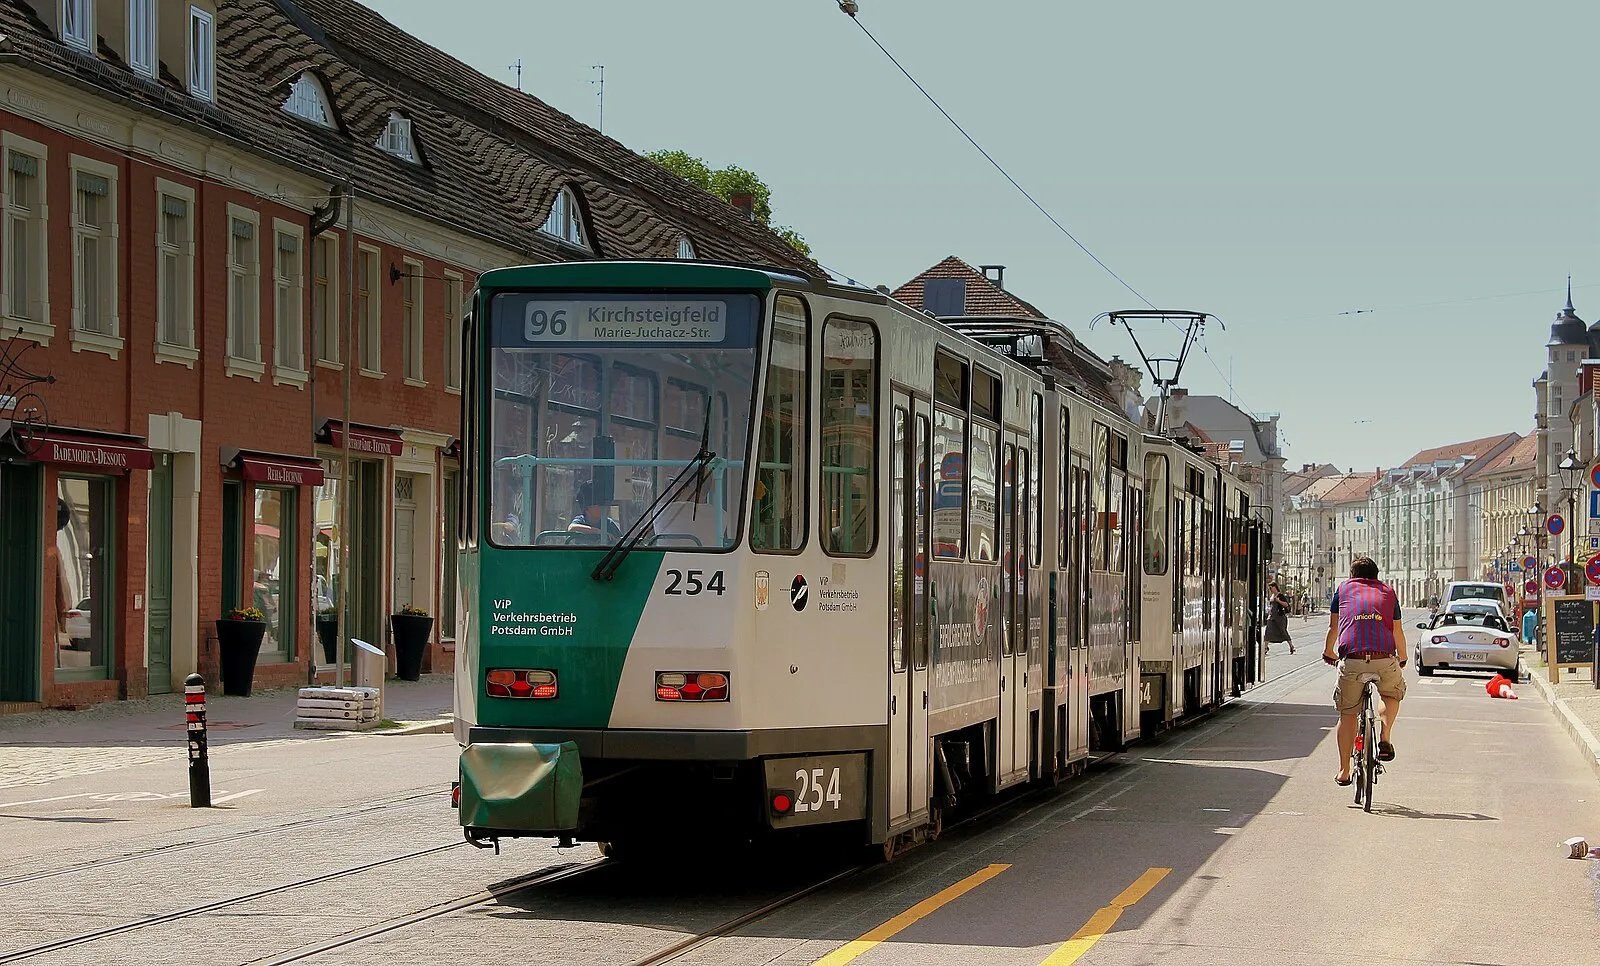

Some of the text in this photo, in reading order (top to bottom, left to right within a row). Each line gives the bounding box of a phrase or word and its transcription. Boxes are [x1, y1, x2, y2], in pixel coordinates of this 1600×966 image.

[530, 306, 720, 336] 96 Kirchsteigfeld
[594, 326, 711, 338] Marie-Juchacz-Str.
[53, 443, 127, 467] BADEMODEN-DESSOUS
[267, 466, 304, 484] REHA-TECHNIK
[664, 569, 726, 596] 254
[819, 576, 829, 586] ViP
[819, 589, 859, 599] Verkehrsbetrieb
[493, 599, 512, 609] ViP
[818, 602, 857, 612] Potsdam GmbH
[493, 612, 577, 623] Verkehrsbetrieb
[1354, 613, 1375, 621] unicef
[491, 625, 573, 636] Potsdam GmbH
[795, 766, 842, 813] 254
